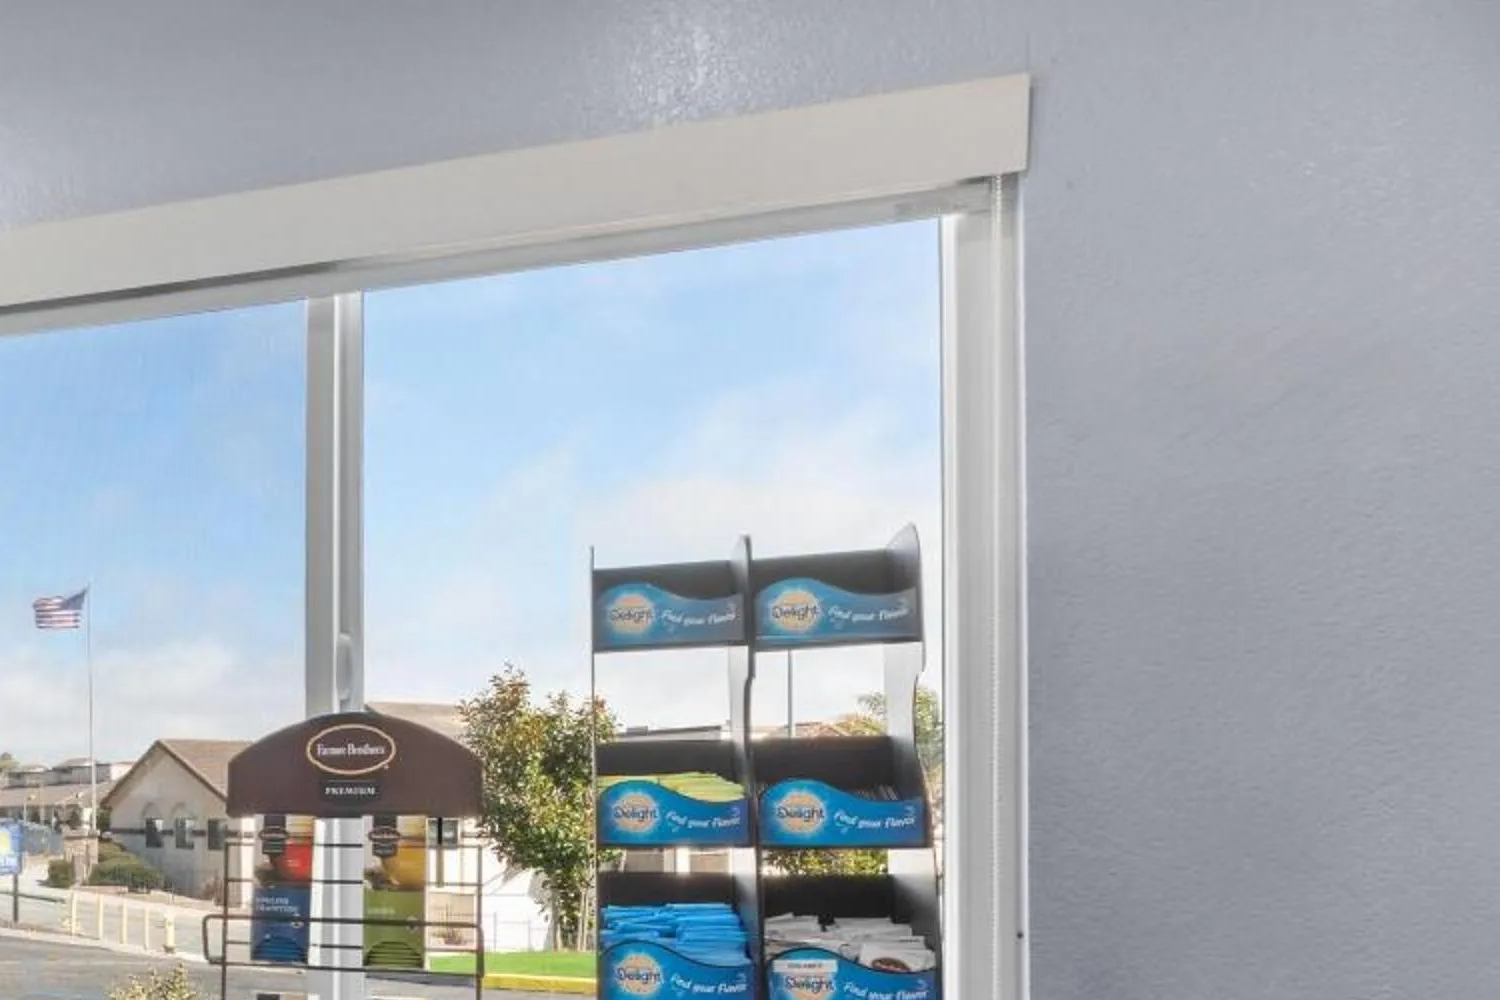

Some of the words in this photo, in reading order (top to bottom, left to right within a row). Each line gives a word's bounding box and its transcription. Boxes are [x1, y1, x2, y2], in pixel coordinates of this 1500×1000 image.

[771, 604, 820, 621] Delight
[612, 804, 659, 823] Delight
[776, 805, 825, 822] Delight
[785, 974, 836, 994] Delight
